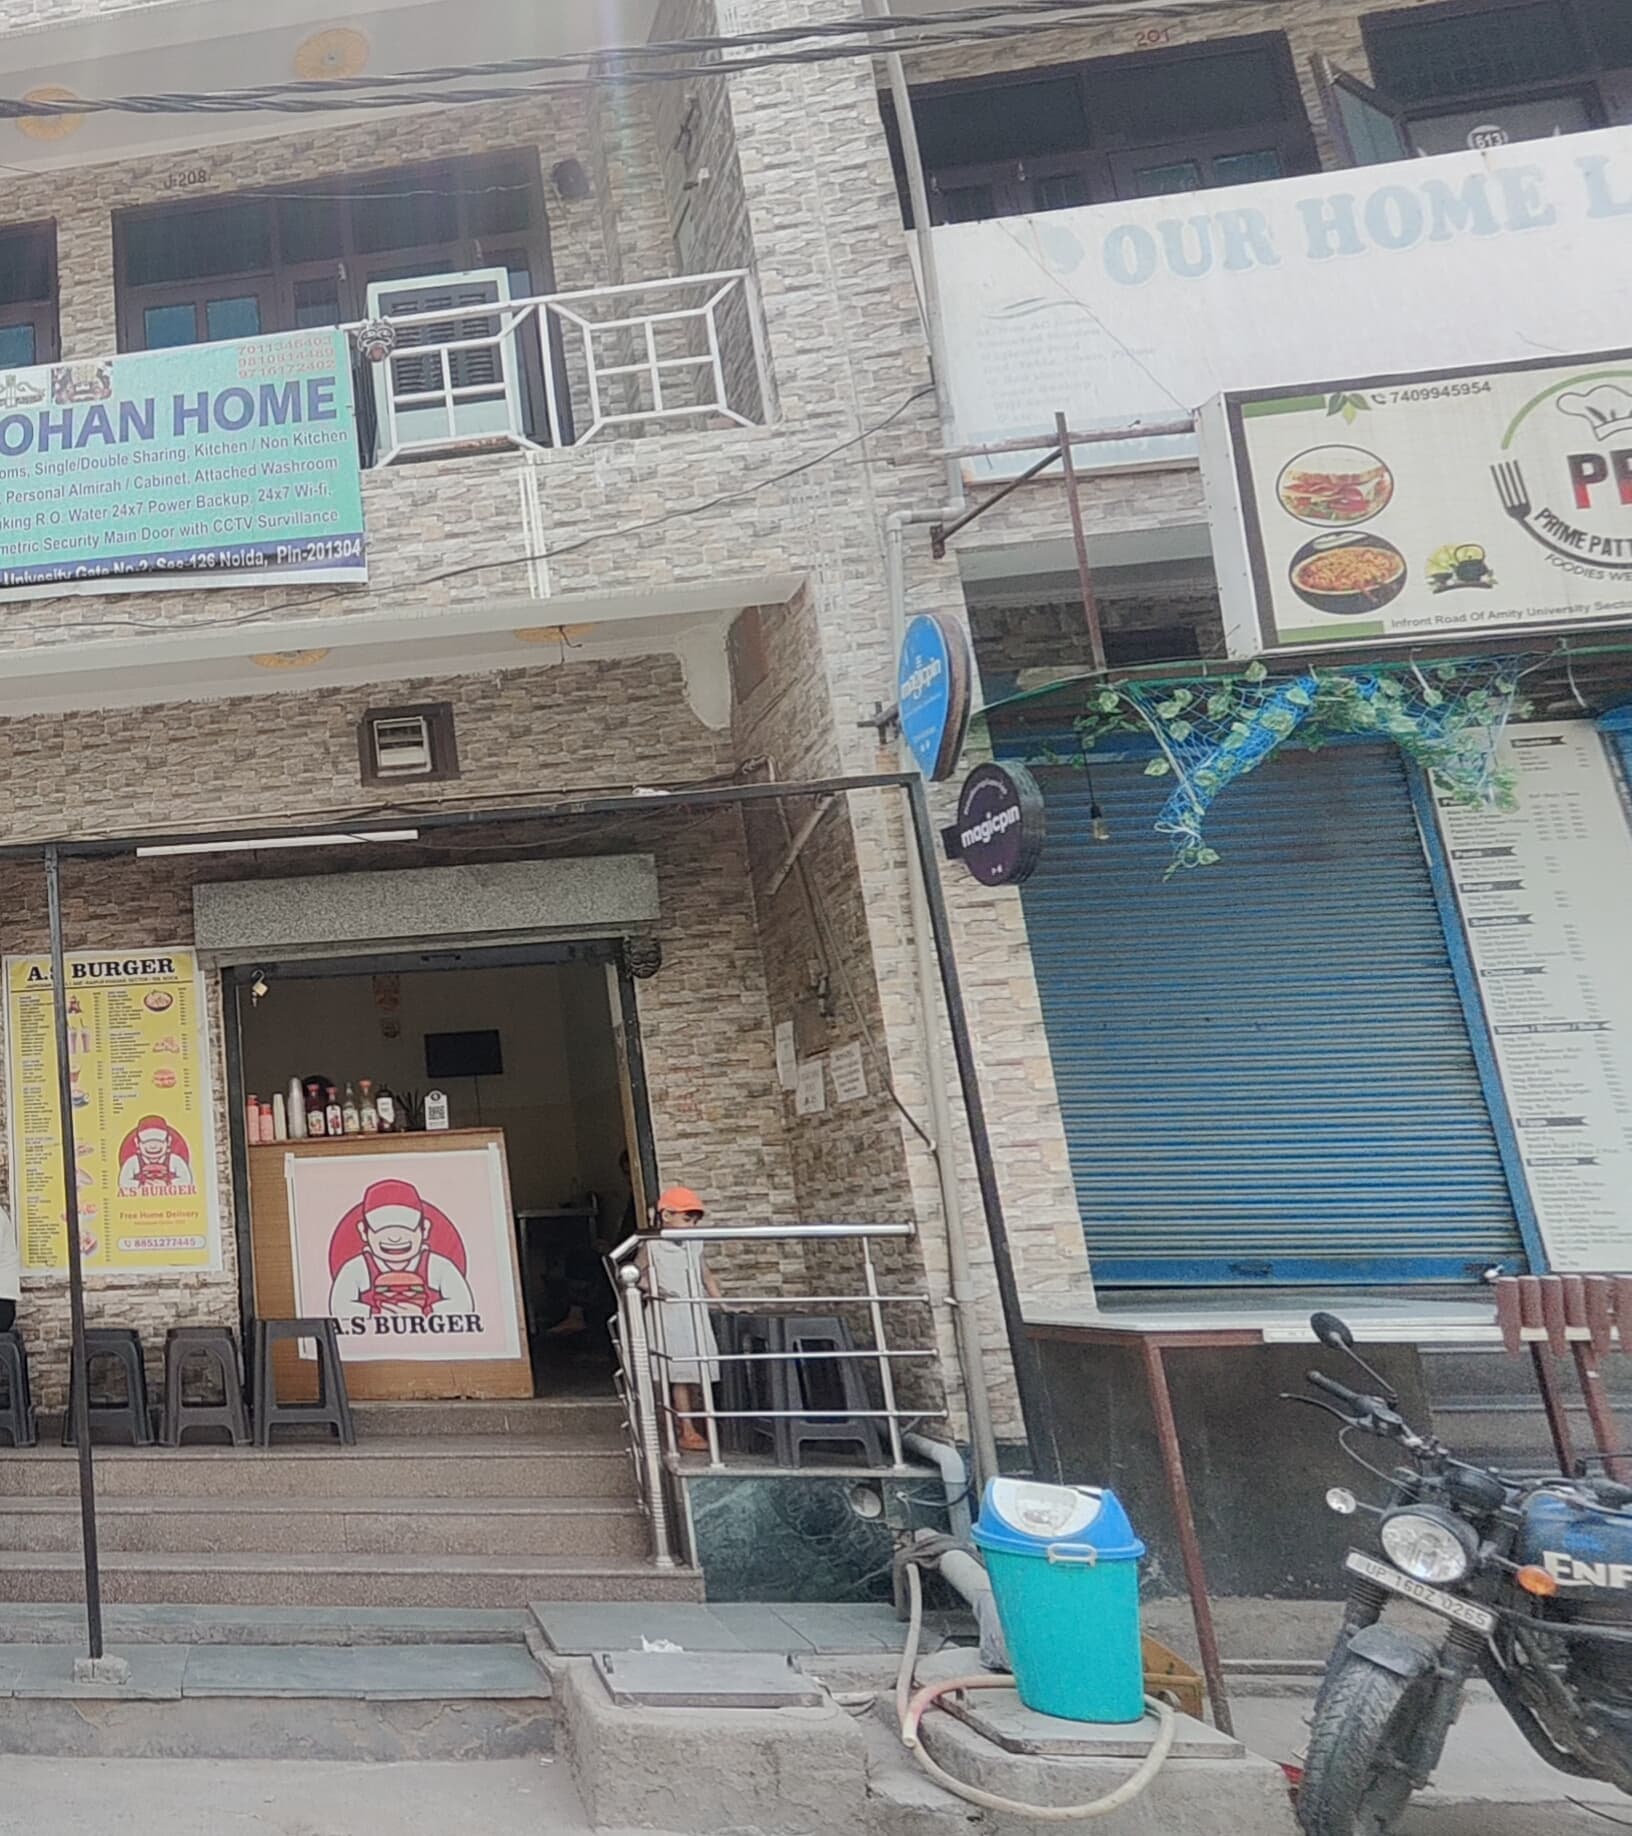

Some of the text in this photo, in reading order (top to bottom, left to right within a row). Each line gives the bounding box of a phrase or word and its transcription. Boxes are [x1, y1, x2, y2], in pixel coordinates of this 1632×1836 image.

[1103, 206, 1281, 287] OUR
[1296, 163, 1556, 261] HOME
[172, 376, 338, 437] HOME
[1390, 380, 1492, 404] 7409945954
[34, 448, 129, 477] Single/Double
[133, 445, 190, 465] Sharing,
[194, 441, 249, 457] Kitchen
[260, 436, 289, 450] Non
[293, 430, 349, 446] Kitchen
[6, 487, 65, 504] Personal
[68, 478, 122, 498] Almirah
[194, 464, 257, 483] Attached
[261, 456, 338, 476] Washroom
[68, 507, 108, 523] Water
[112, 501, 144, 518] 24x7
[148, 496, 192, 514] Power
[257, 485, 290, 502] 24x7
[43, 534, 100, 551] Security
[104, 529, 137, 545] Main
[141, 524, 175, 541] Door
[179, 519, 209, 537] with
[213, 515, 254, 533] CCTV
[257, 509, 339, 529] Survillance
[1534, 507, 1588, 550] PRIME
[276, 539, 362, 563] Pin-201304
[1544, 553, 1605, 581] FOODIES
[1391, 602, 1591, 630] Infront Road Of Amity University
[960, 805, 1021, 848] magicpin
[71, 957, 176, 979] BURGER
[141, 1184, 198, 1197] BURGER
[374, 1312, 485, 1335] BURGER
[1365, 1562, 1386, 1579] UP
